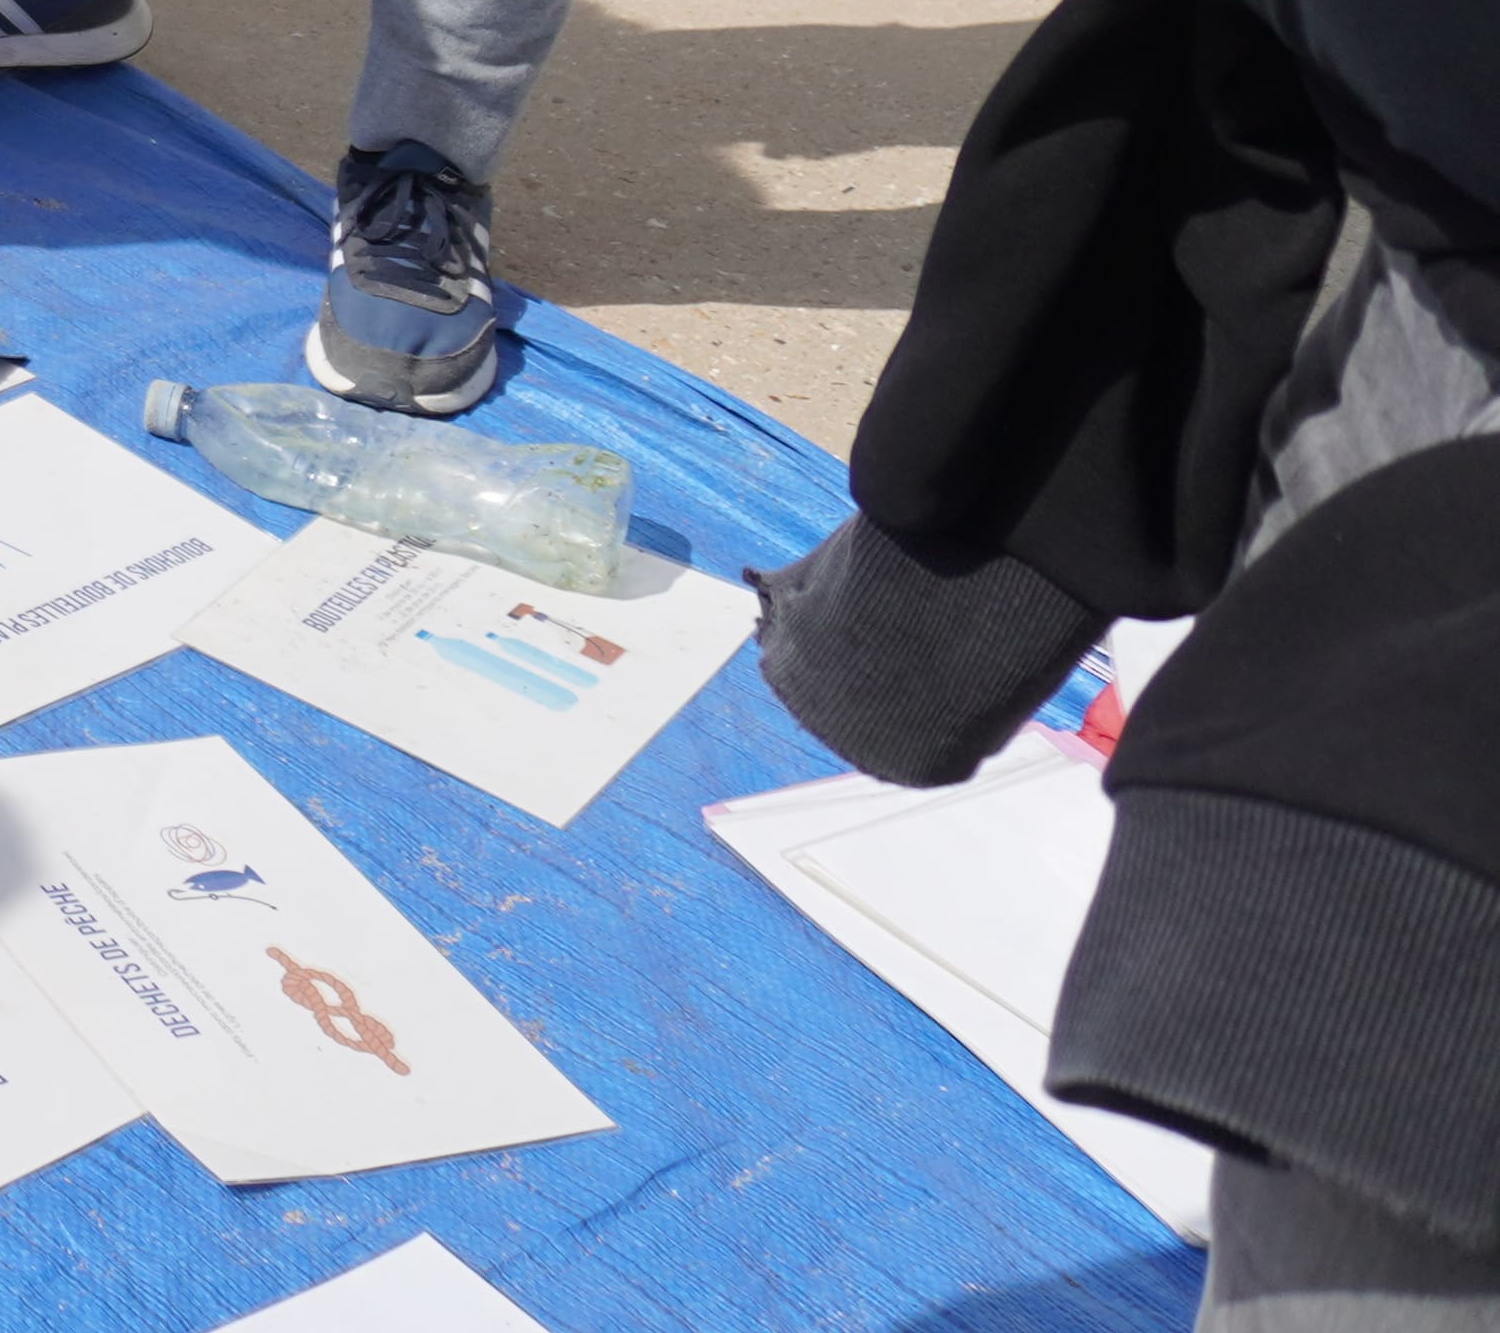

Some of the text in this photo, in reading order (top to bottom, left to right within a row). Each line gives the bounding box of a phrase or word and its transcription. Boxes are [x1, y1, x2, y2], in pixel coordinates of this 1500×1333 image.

[126, 537, 214, 580] BOUCHONS
[375, 533, 436, 572] PLASTIQ
[104, 571, 137, 590] DE
[360, 565, 394, 584] EN
[17, 580, 116, 629] BOUTEILLES
[302, 577, 378, 633] BOUTEILLES
[40, 883, 107, 936] PÊCHE
[89, 938, 129, 961] DE
[113, 962, 201, 1038] DECHETS
